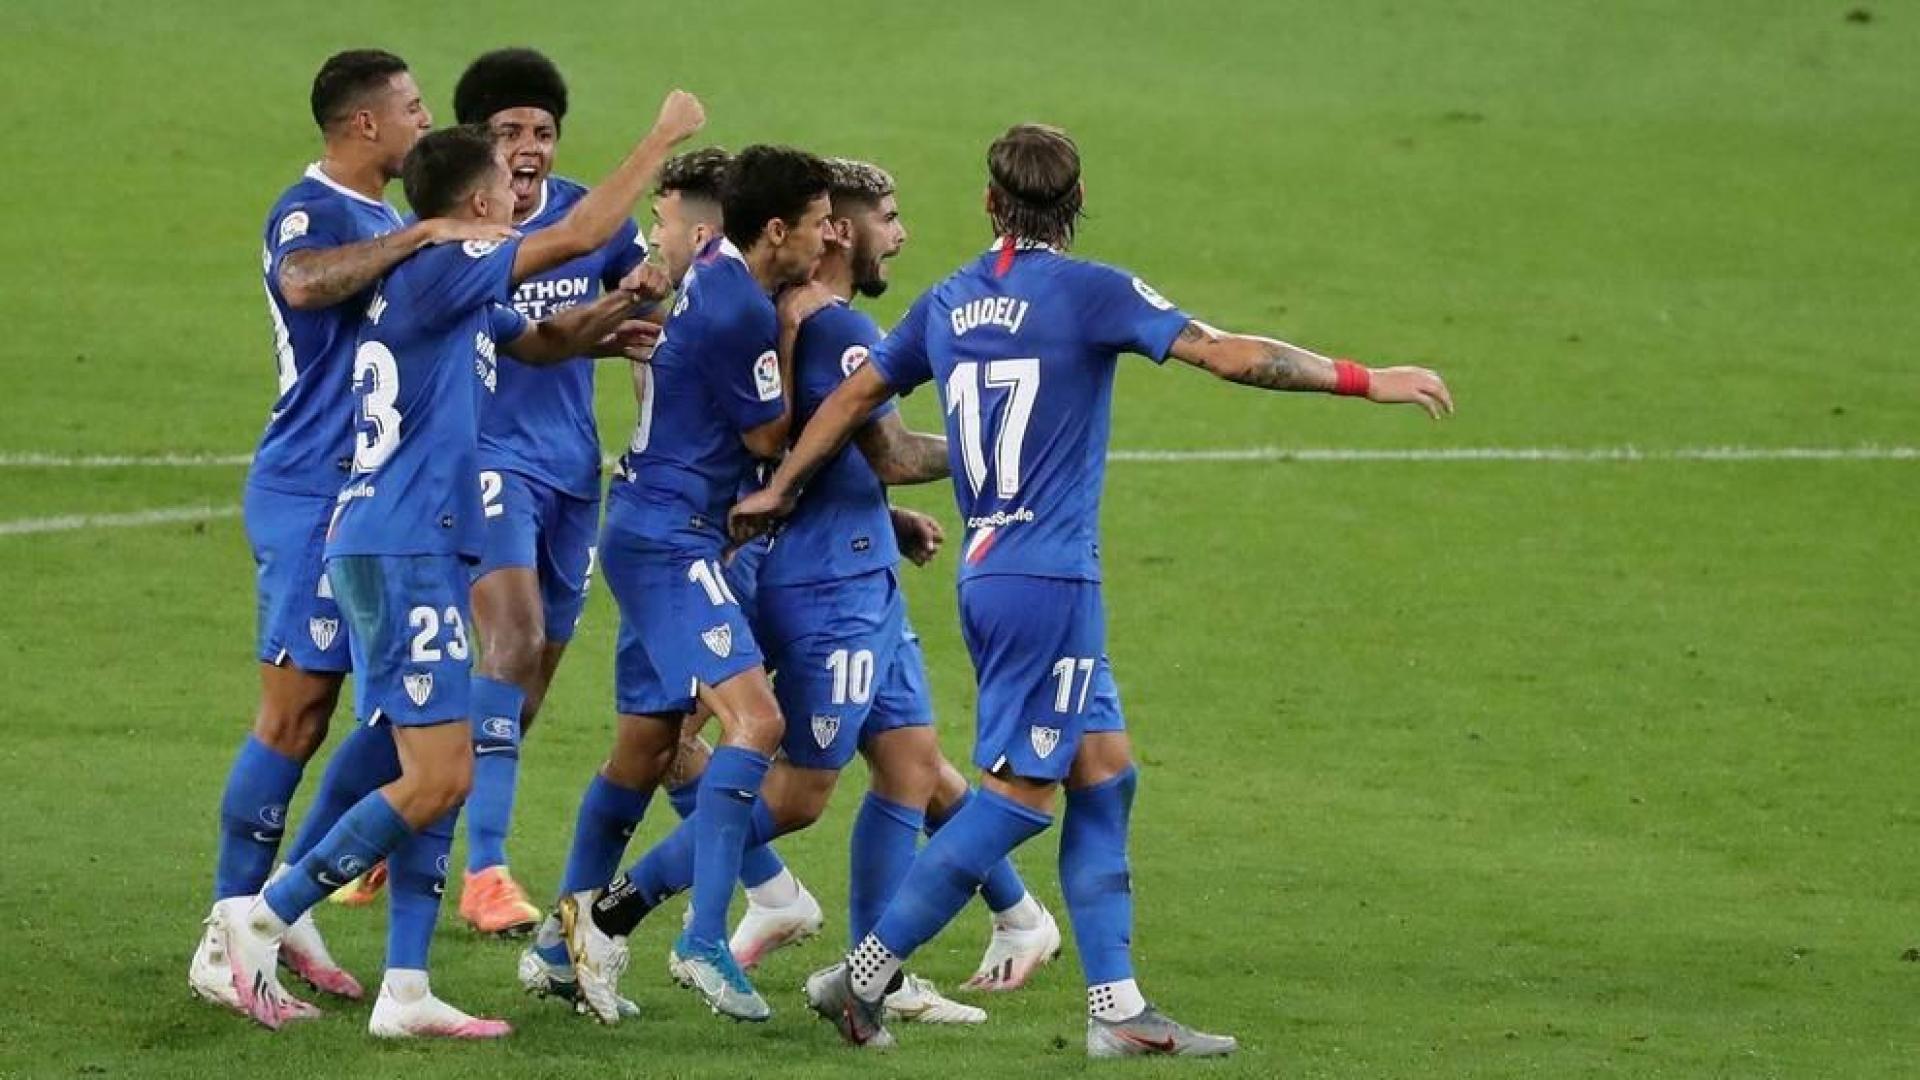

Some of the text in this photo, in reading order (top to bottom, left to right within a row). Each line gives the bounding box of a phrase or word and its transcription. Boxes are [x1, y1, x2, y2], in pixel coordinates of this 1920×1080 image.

[951, 296, 1029, 336] GUDELJ
[946, 358, 1040, 500] 17
[409, 606, 468, 662] 23
[825, 649, 873, 705] 10
[1052, 656, 1095, 714] 17
